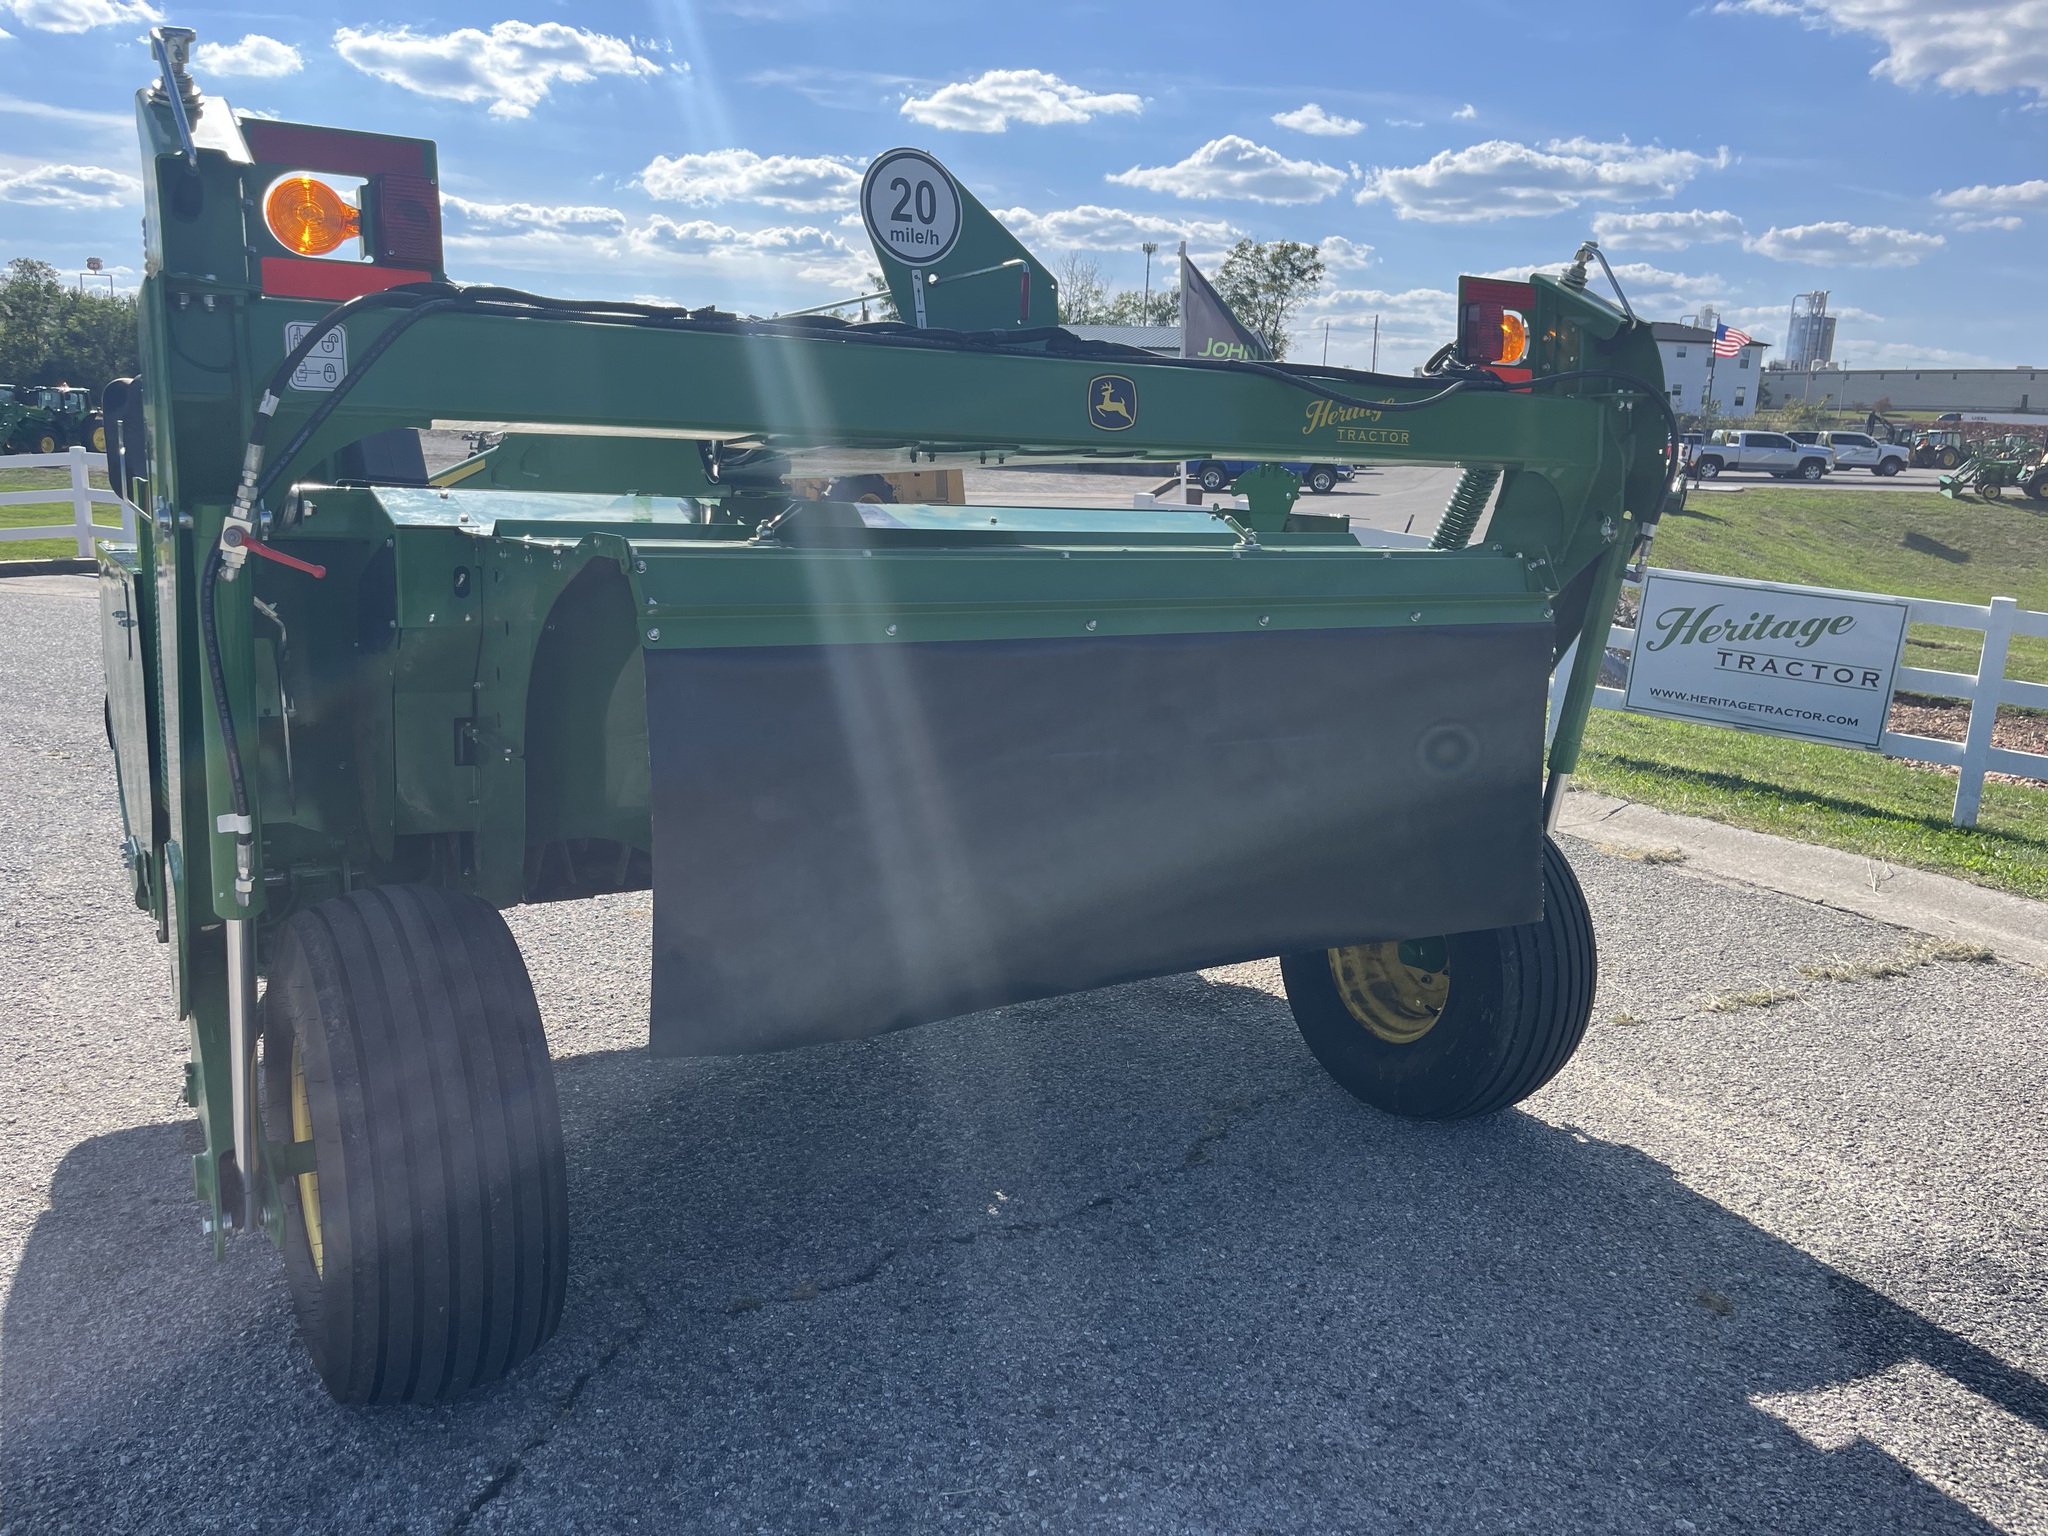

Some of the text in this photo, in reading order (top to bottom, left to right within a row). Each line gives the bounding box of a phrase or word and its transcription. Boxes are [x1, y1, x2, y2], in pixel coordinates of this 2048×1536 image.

[890, 177, 936, 225] 20
[890, 227, 939, 245] mile/h
[1197, 337, 1258, 361] JOHN
[1337, 429, 1409, 443] TRACTOR
[1646, 604, 1857, 651] Heritage
[1717, 651, 1881, 688] TRACTOR
[1649, 687, 1859, 727] WWW.HERITAGETRACTOR.COM
